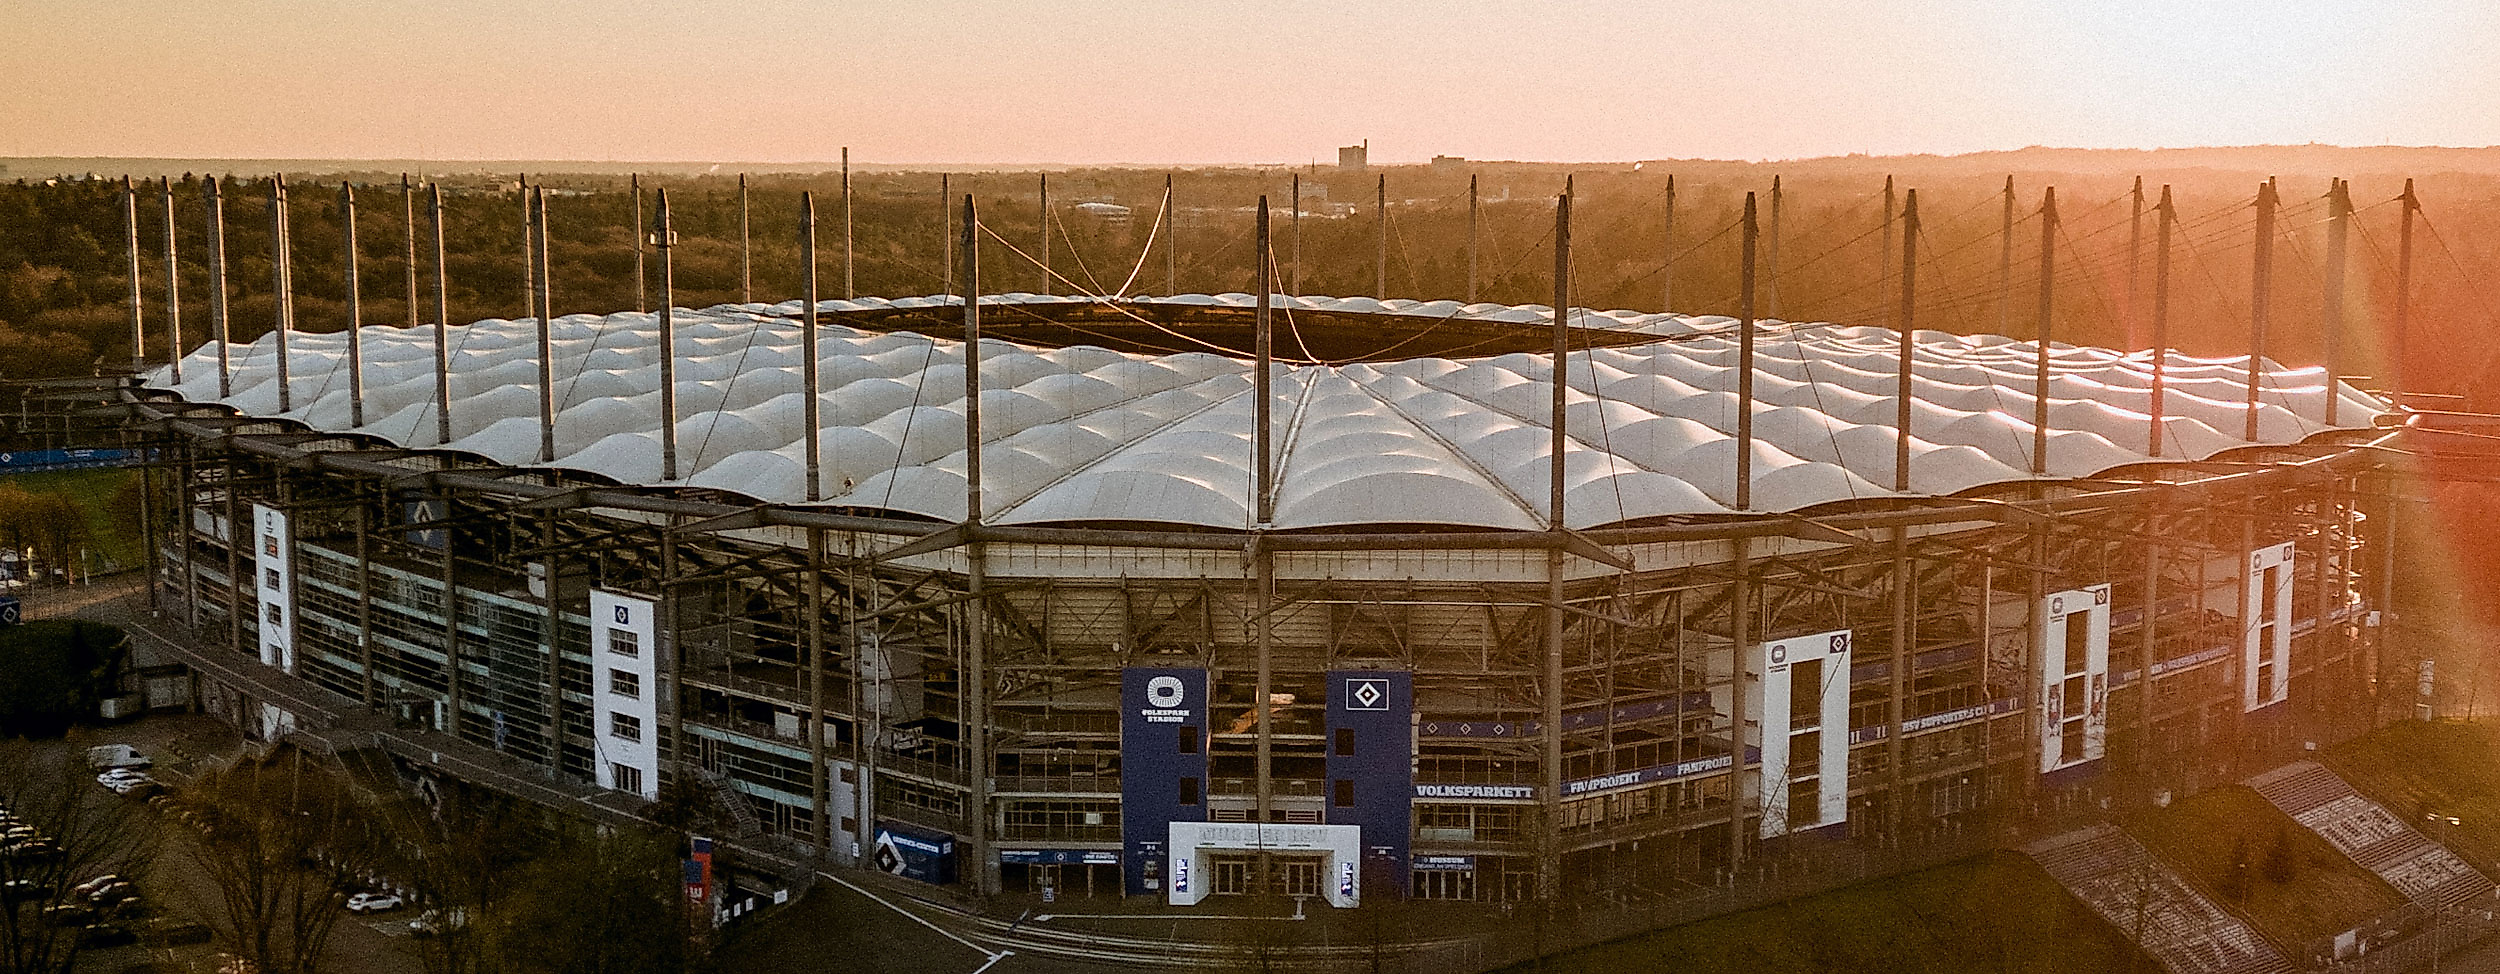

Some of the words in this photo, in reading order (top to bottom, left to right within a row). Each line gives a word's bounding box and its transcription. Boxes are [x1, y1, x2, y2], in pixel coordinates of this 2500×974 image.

[1141, 708, 1190, 717] VOLKSPARK
[1147, 715, 1184, 723] STADION
[1570, 772, 1641, 793] FANPROJEKT
[1416, 785, 1534, 798] VOLKSPARKETT
